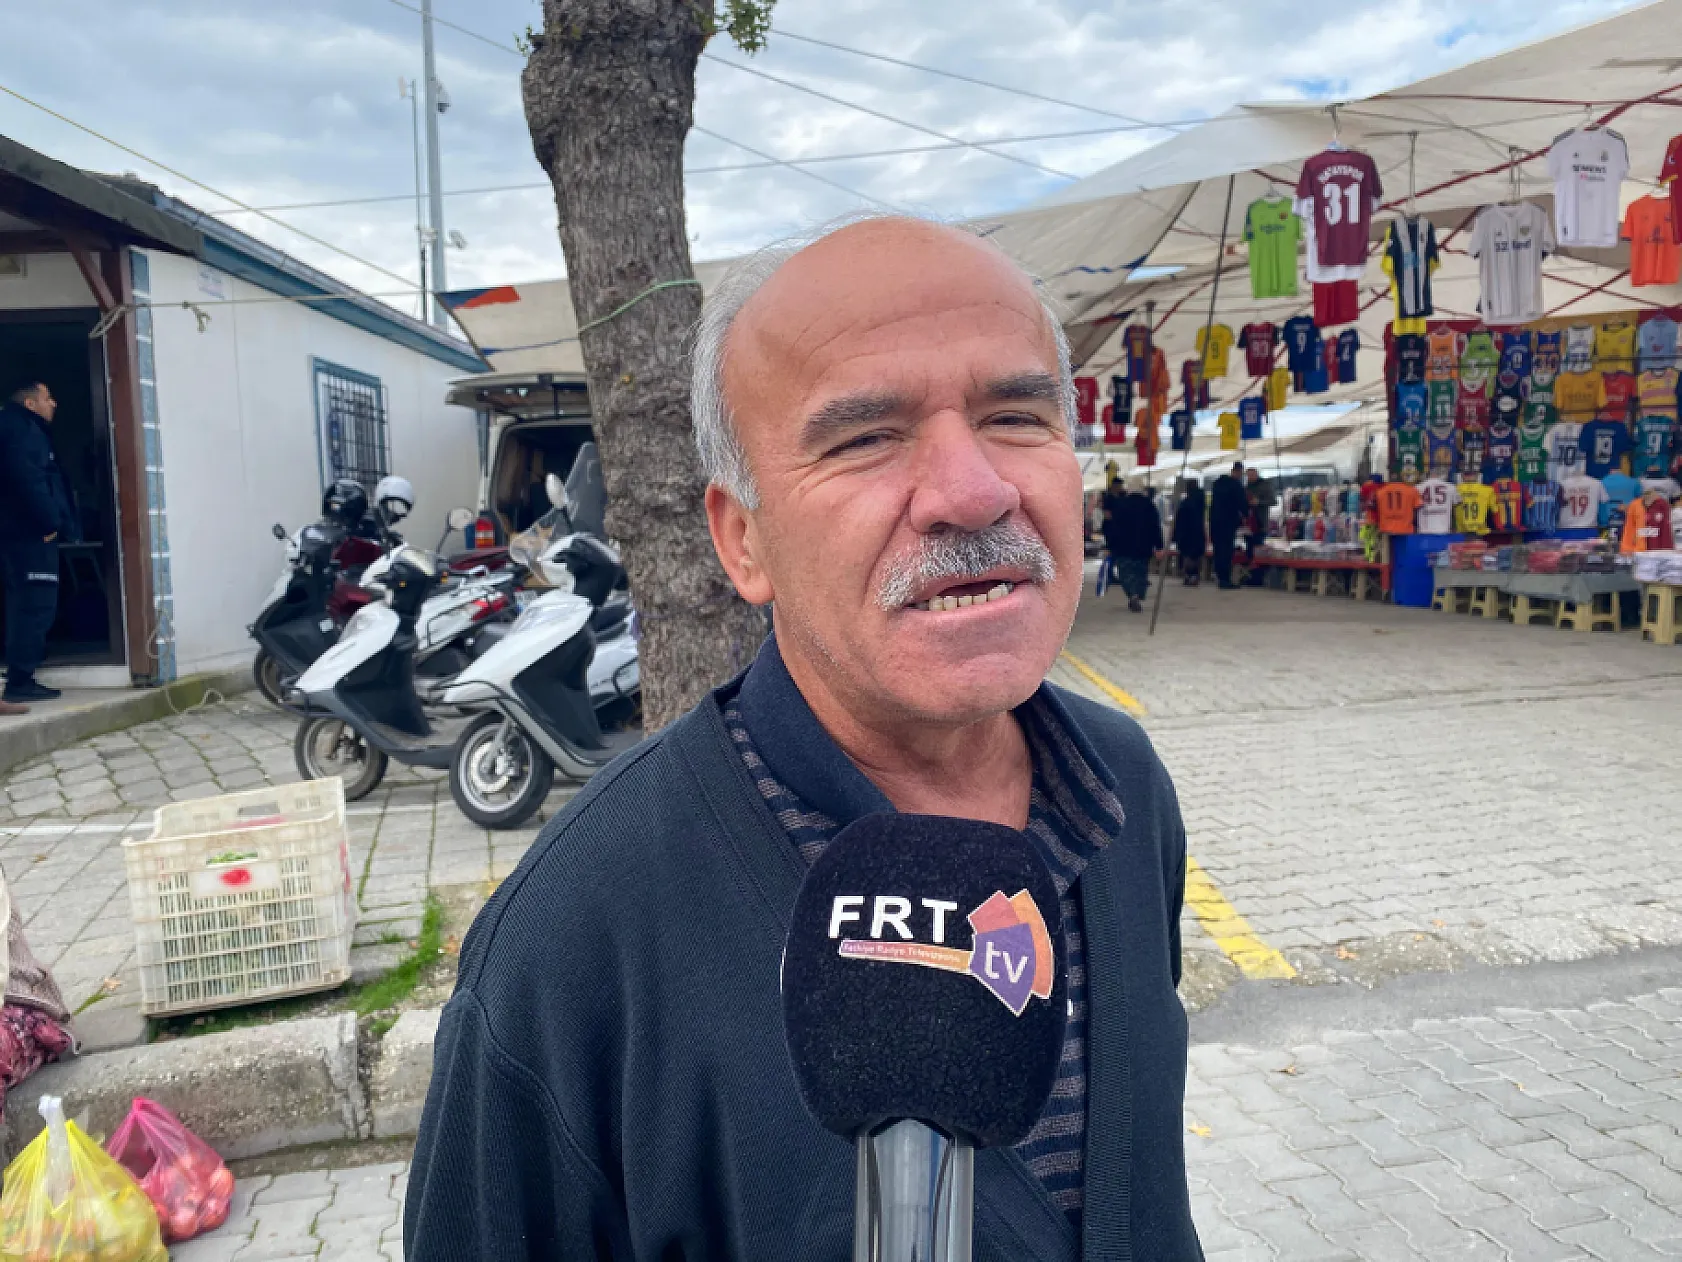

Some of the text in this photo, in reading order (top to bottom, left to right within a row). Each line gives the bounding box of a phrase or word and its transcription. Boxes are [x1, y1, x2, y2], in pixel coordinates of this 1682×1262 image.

[1323, 183, 1361, 226] 31
[1387, 492, 1403, 510] 11
[1422, 485, 1448, 505] 45
[1463, 501, 1479, 520] 19
[1570, 496, 1589, 518] 19
[828, 895, 958, 944] FRT
[983, 941, 1029, 984] tv
